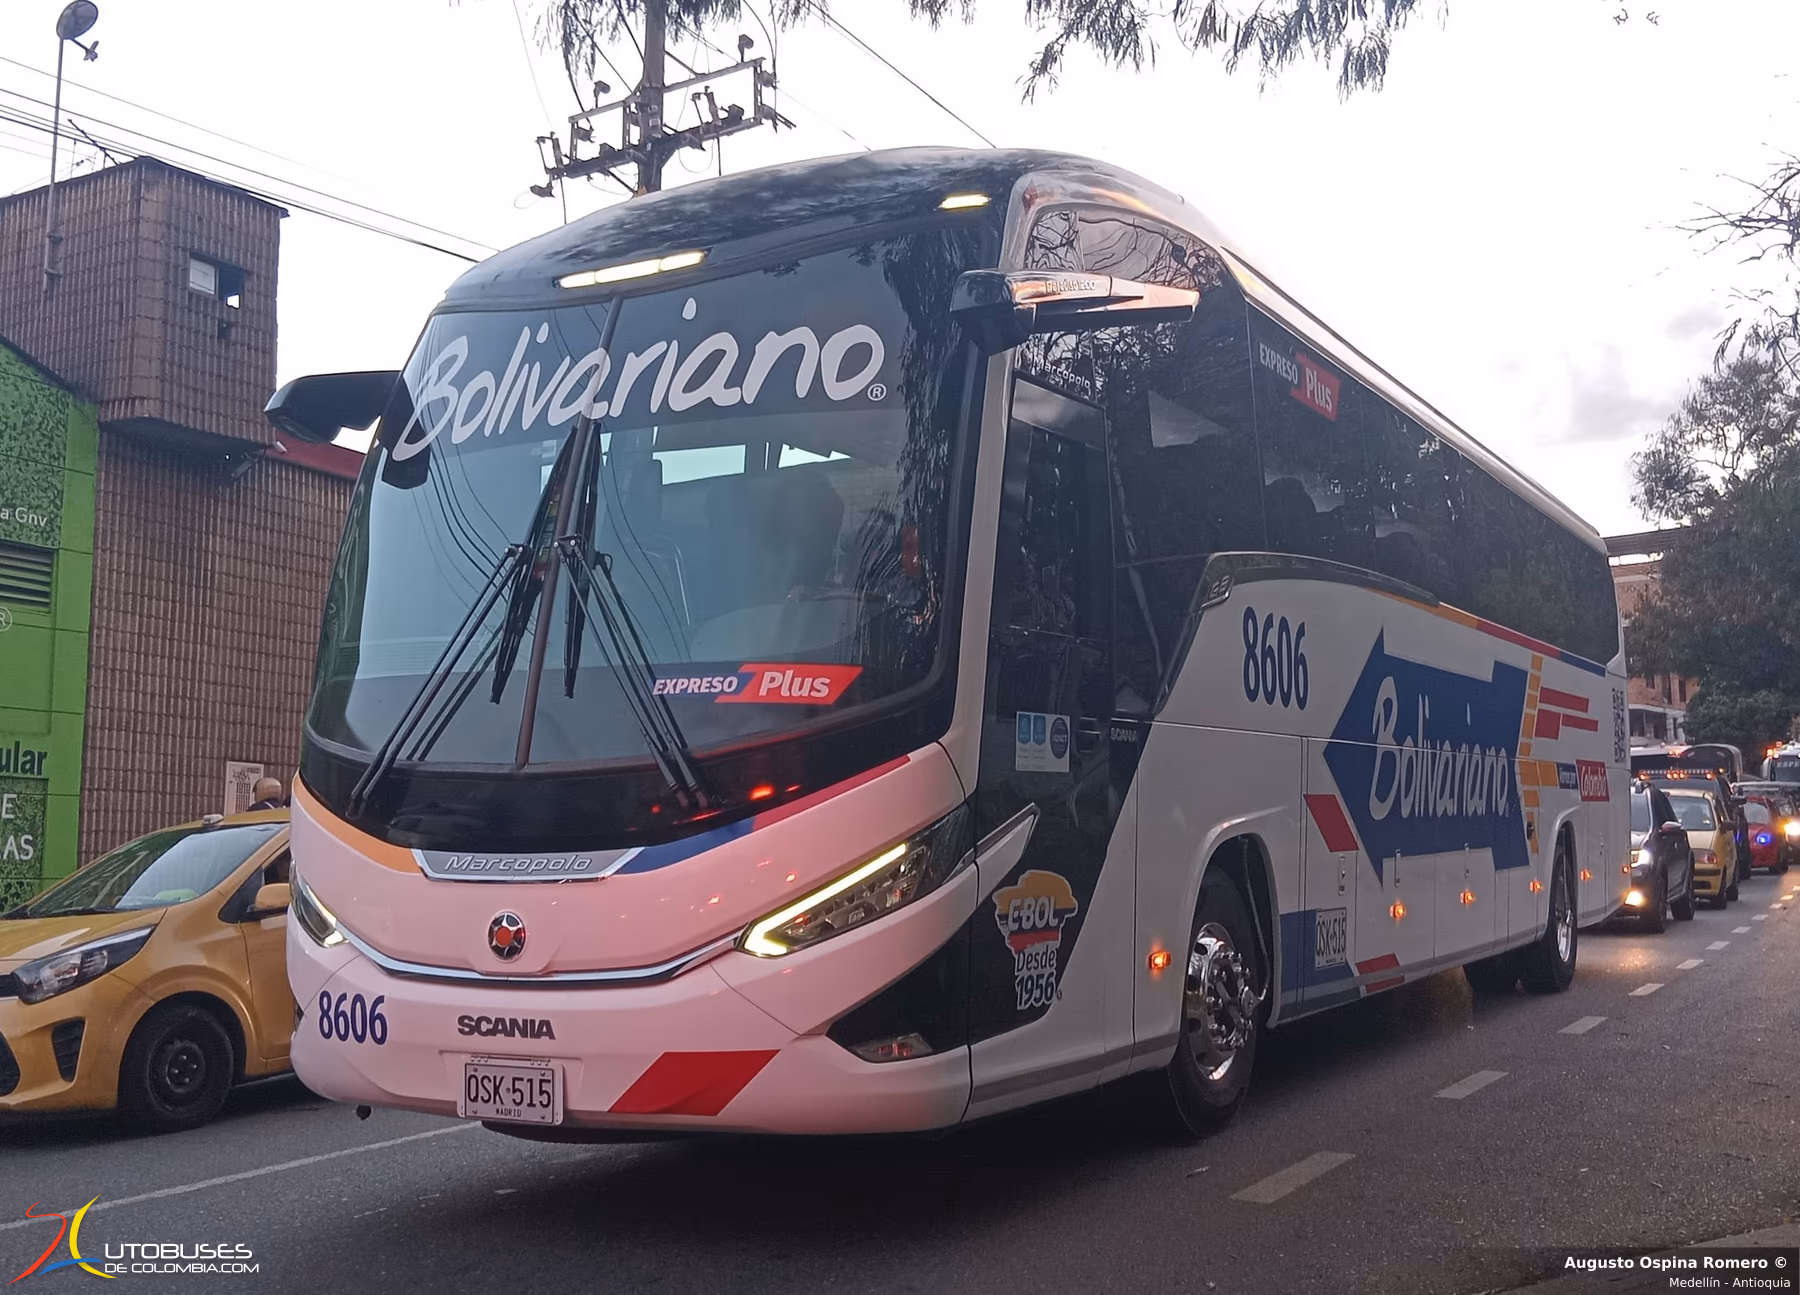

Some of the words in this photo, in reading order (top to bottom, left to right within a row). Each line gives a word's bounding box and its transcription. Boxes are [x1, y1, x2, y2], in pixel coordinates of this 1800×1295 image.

[392, 297, 885, 461] Bolivariano
[1033, 356, 1091, 389] Marcopolo
[1260, 342, 1299, 385] EXPRESO
[1305, 367, 1333, 413] Plus
[15, 507, 48, 527] Gnv
[1243, 606, 1309, 708] 8606
[652, 675, 739, 696] EXPRESO
[758, 669, 831, 698] Plus
[0, 740, 48, 776] ular
[1369, 676, 1509, 821] Bolivariano
[443, 854, 593, 873] Marcopolo
[1017, 944, 1056, 973] Desde
[1016, 970, 1056, 1009] 1956
[318, 990, 388, 1045] 8606
[457, 1015, 556, 1040] SCANIA
[495, 1107, 522, 1118] MADRID
